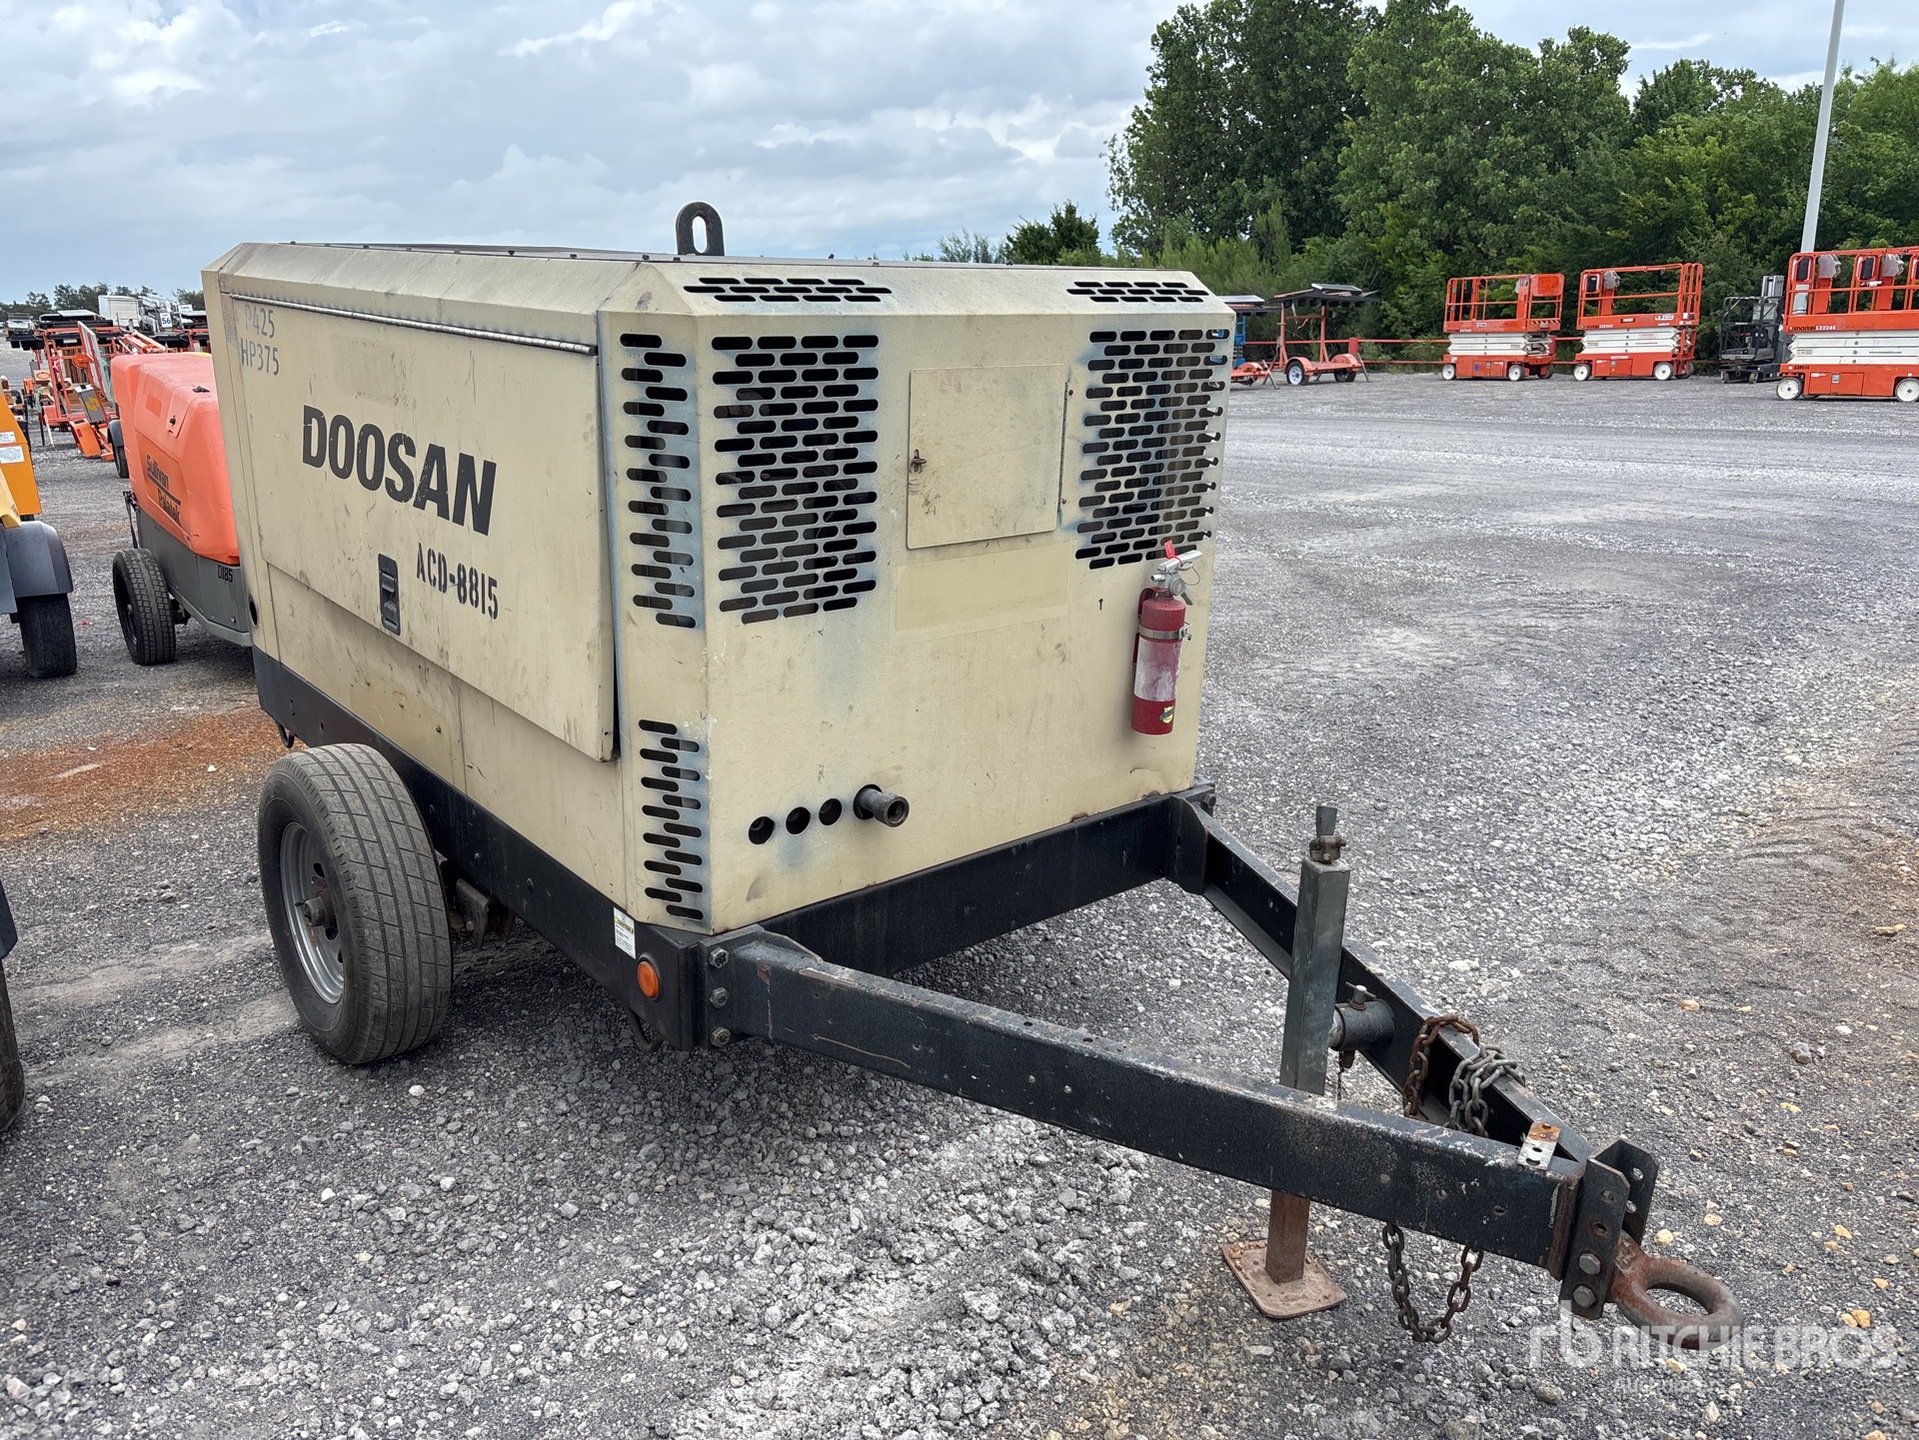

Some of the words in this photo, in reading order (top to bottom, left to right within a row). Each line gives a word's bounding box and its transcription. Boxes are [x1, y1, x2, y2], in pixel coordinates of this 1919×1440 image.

[162, 317, 171, 325] 56
[245, 304, 275, 339] P425
[241, 338, 280, 376] HP375
[147, 454, 169, 491] Sullivan
[303, 404, 497, 536] DOOSAN
[416, 542, 498, 620] ACD-8815
